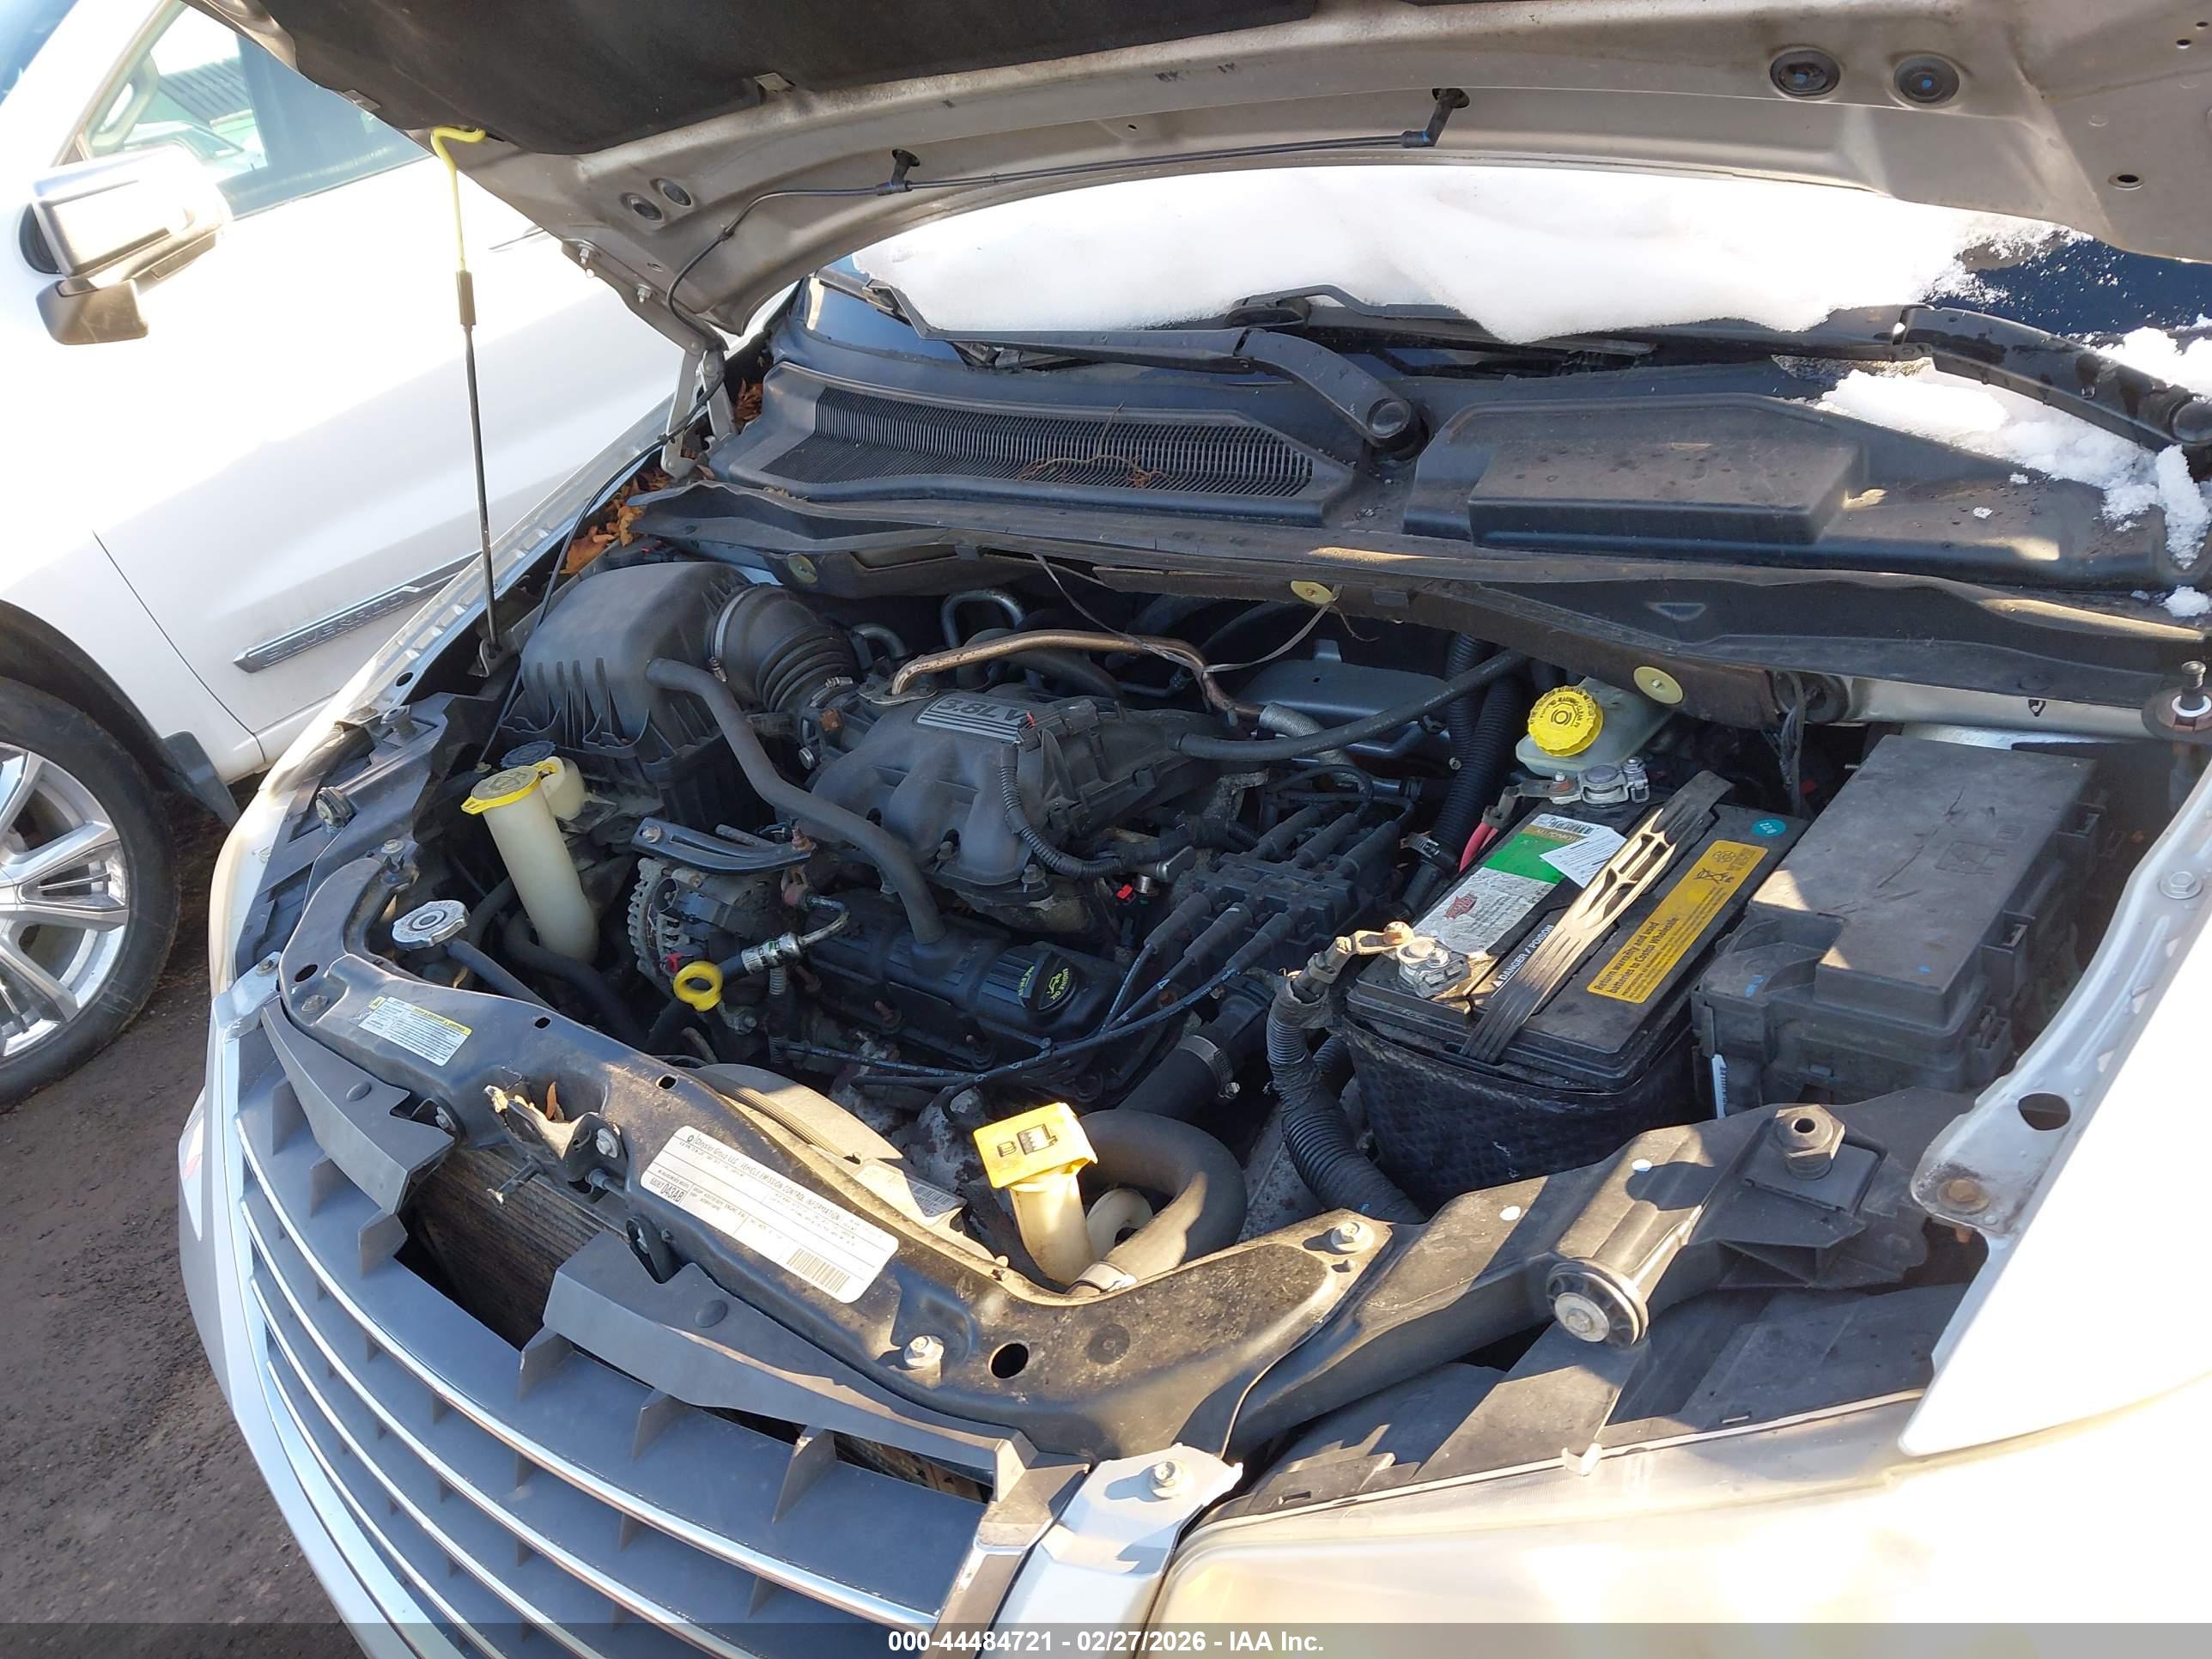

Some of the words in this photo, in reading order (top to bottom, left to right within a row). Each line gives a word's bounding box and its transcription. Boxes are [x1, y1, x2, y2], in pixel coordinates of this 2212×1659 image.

[267, 596, 404, 659] SILVERADO
[937, 699, 999, 718] 3.8L
[1062, 968, 1071, 991] ENGINE
[1498, 954, 1528, 981] DANGER
[1528, 925, 1555, 949] POISON
[1593, 969, 1616, 990] Return
[1614, 942, 1640, 972] warranty
[1634, 933, 1647, 947] and
[1644, 921, 1661, 935] used
[1606, 966, 1634, 994] batteries
[1629, 957, 1640, 969] to
[1635, 943, 1654, 962] Costco
[1650, 915, 1680, 945] Wholesale
[1049, 989, 1061, 1000] OIL
[727, 1154, 738, 1164] LLC
[739, 1162, 761, 1176] VEHICLE
[759, 1173, 784, 1189] EMISSION
[781, 1185, 805, 1201] CONTROL
[805, 1198, 841, 1220] INFORMATION
